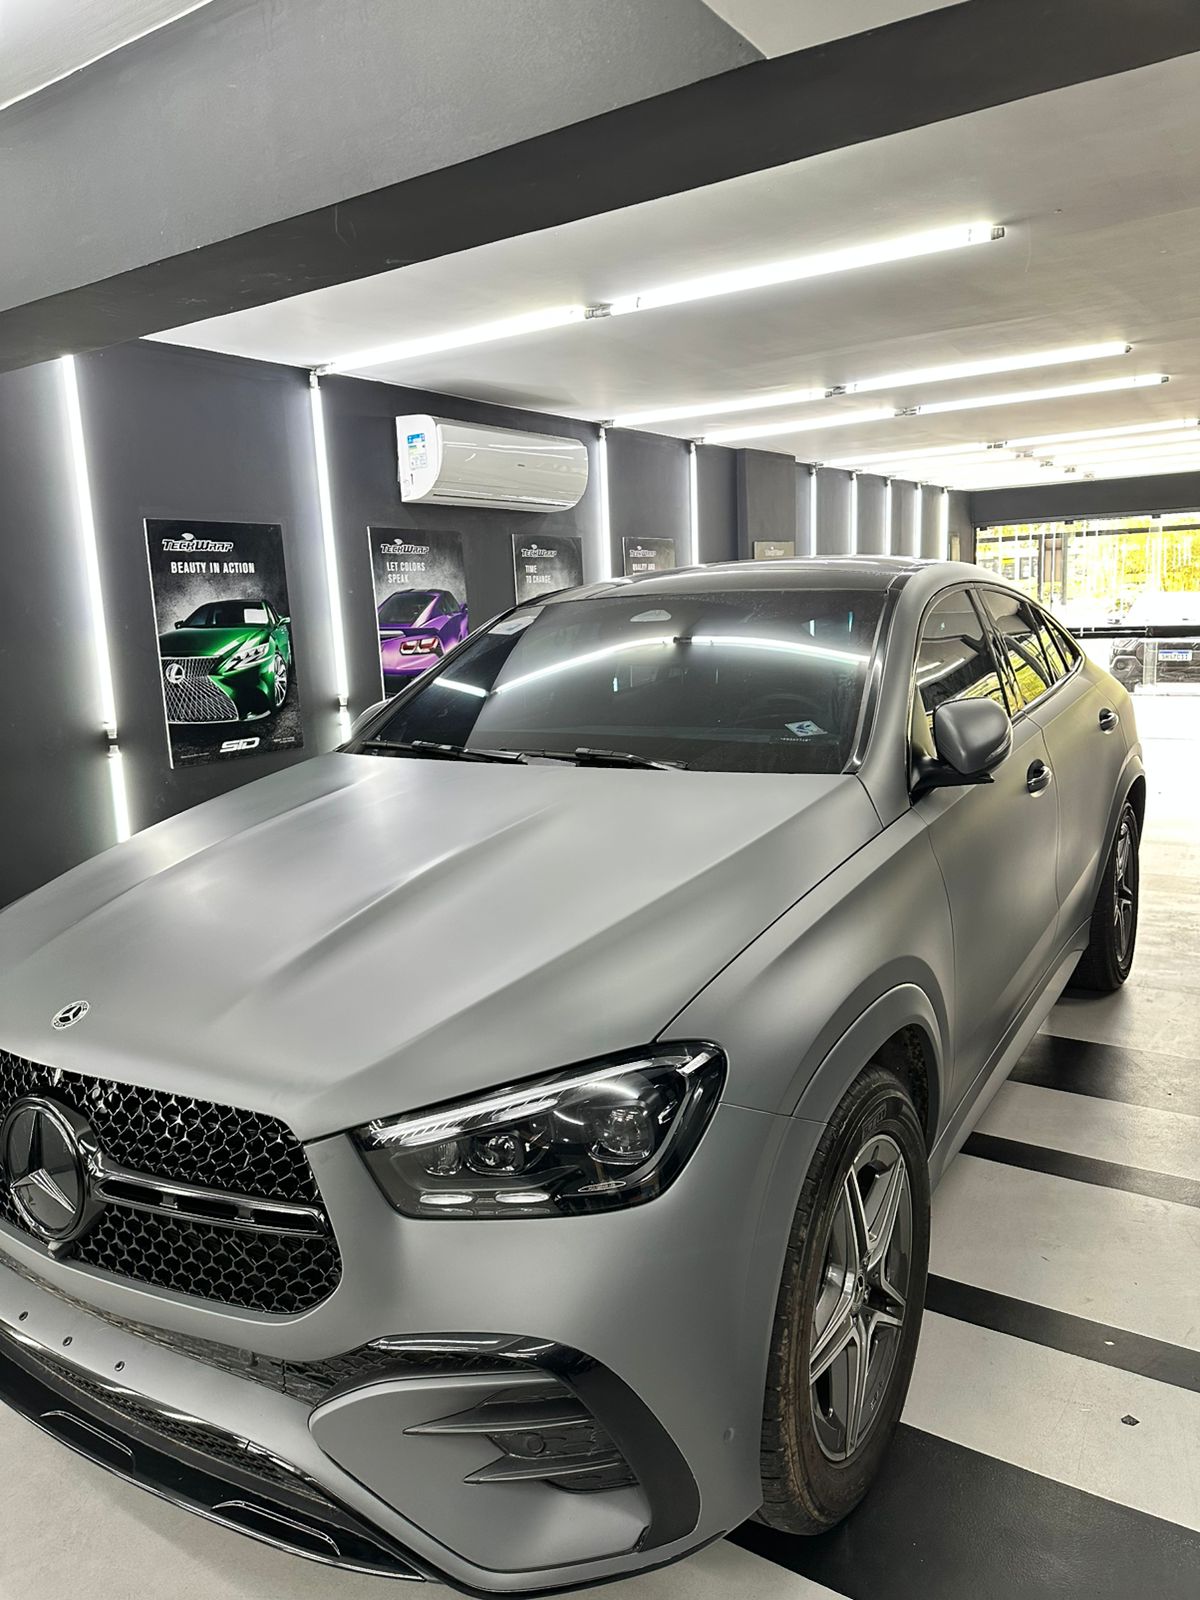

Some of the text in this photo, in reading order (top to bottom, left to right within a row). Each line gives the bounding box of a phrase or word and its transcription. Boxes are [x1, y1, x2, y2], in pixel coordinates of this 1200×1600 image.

[170, 561, 256, 574] BEAUTY IN ACTION
[386, 561, 426, 572] LET COLORS
[387, 573, 410, 584] SPEAK
